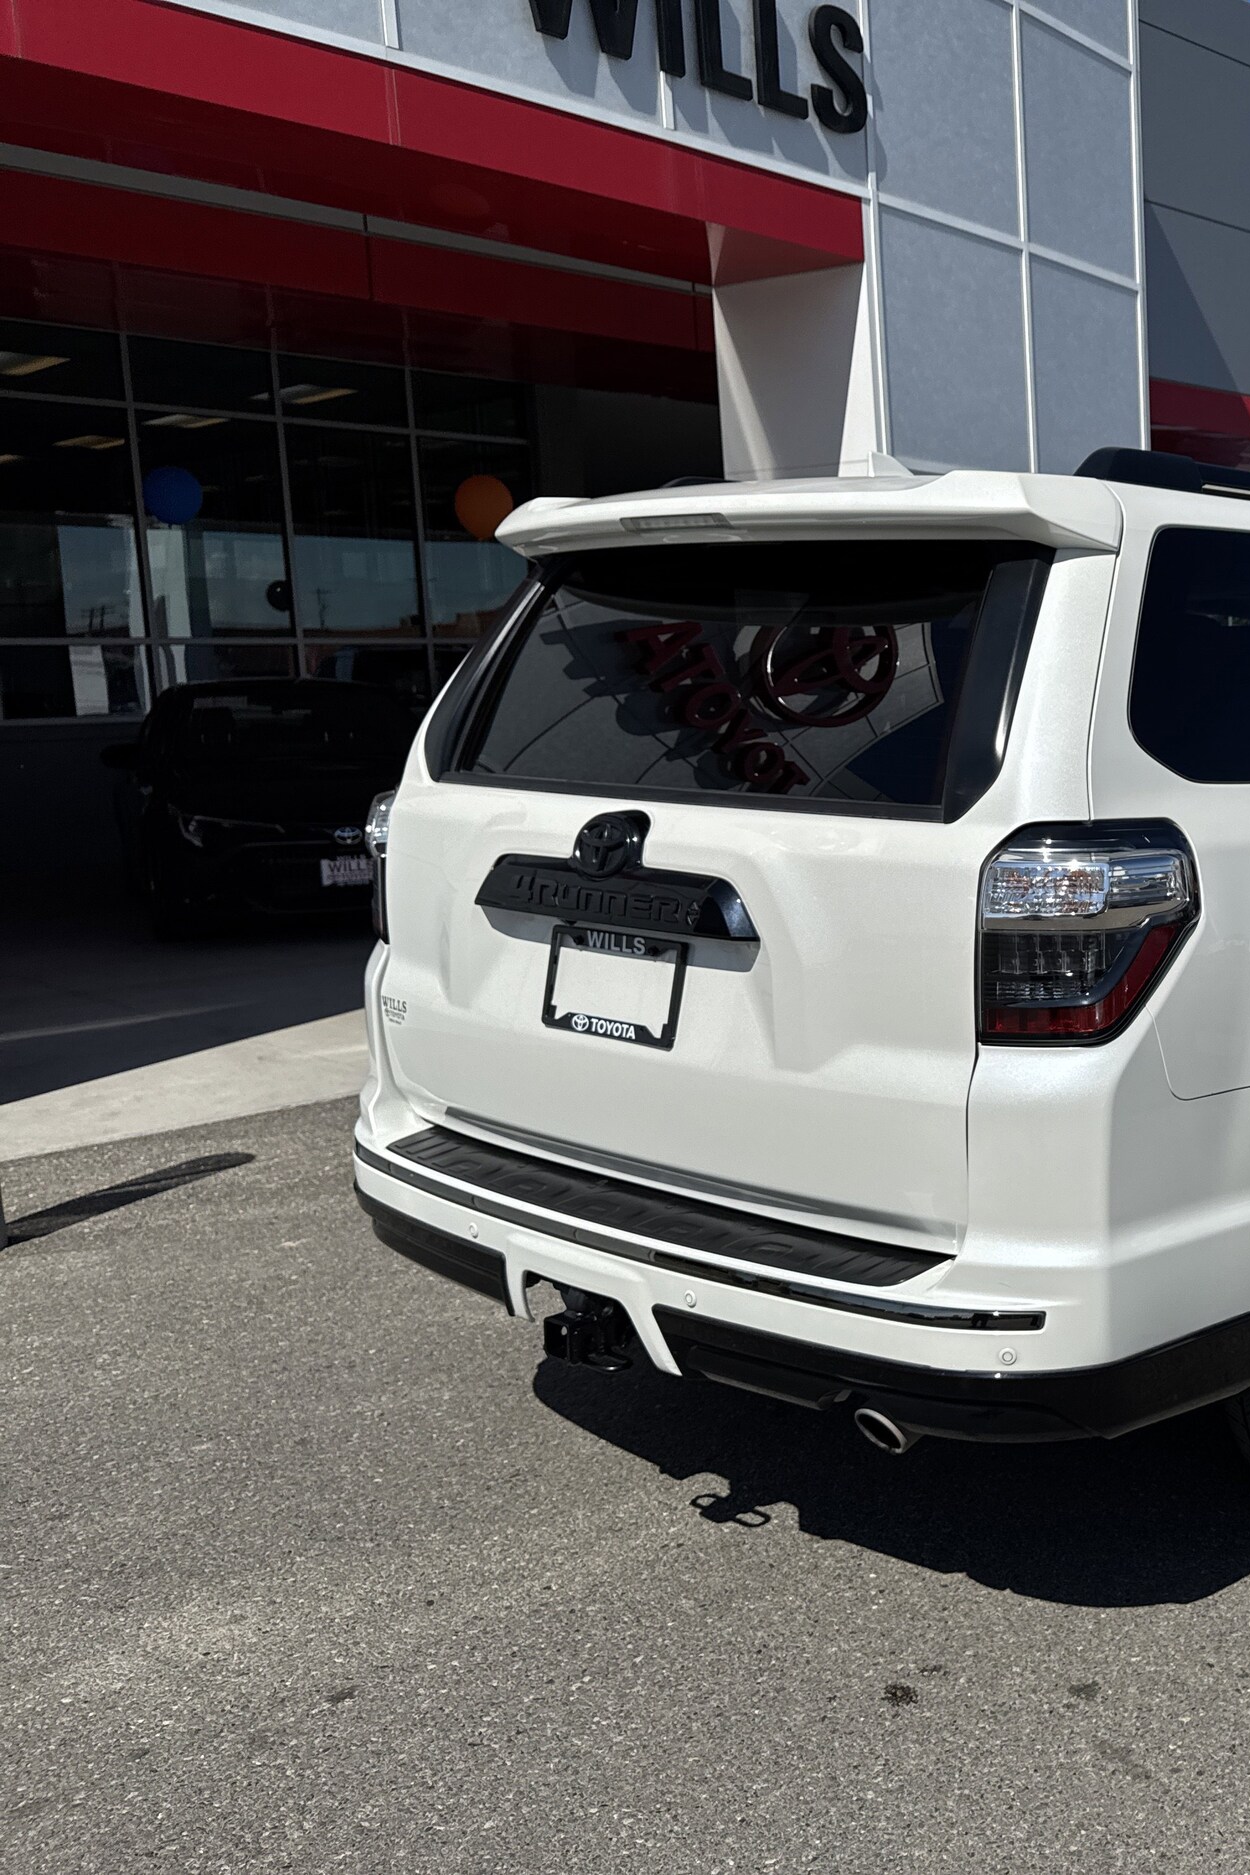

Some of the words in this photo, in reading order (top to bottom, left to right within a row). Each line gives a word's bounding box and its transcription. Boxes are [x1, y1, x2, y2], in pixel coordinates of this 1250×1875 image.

[509, 870, 680, 924] 4RUNNER
[586, 930, 646, 955] WILLS
[381, 995, 407, 1014] WILLS
[591, 1017, 636, 1040] TOYOTA
